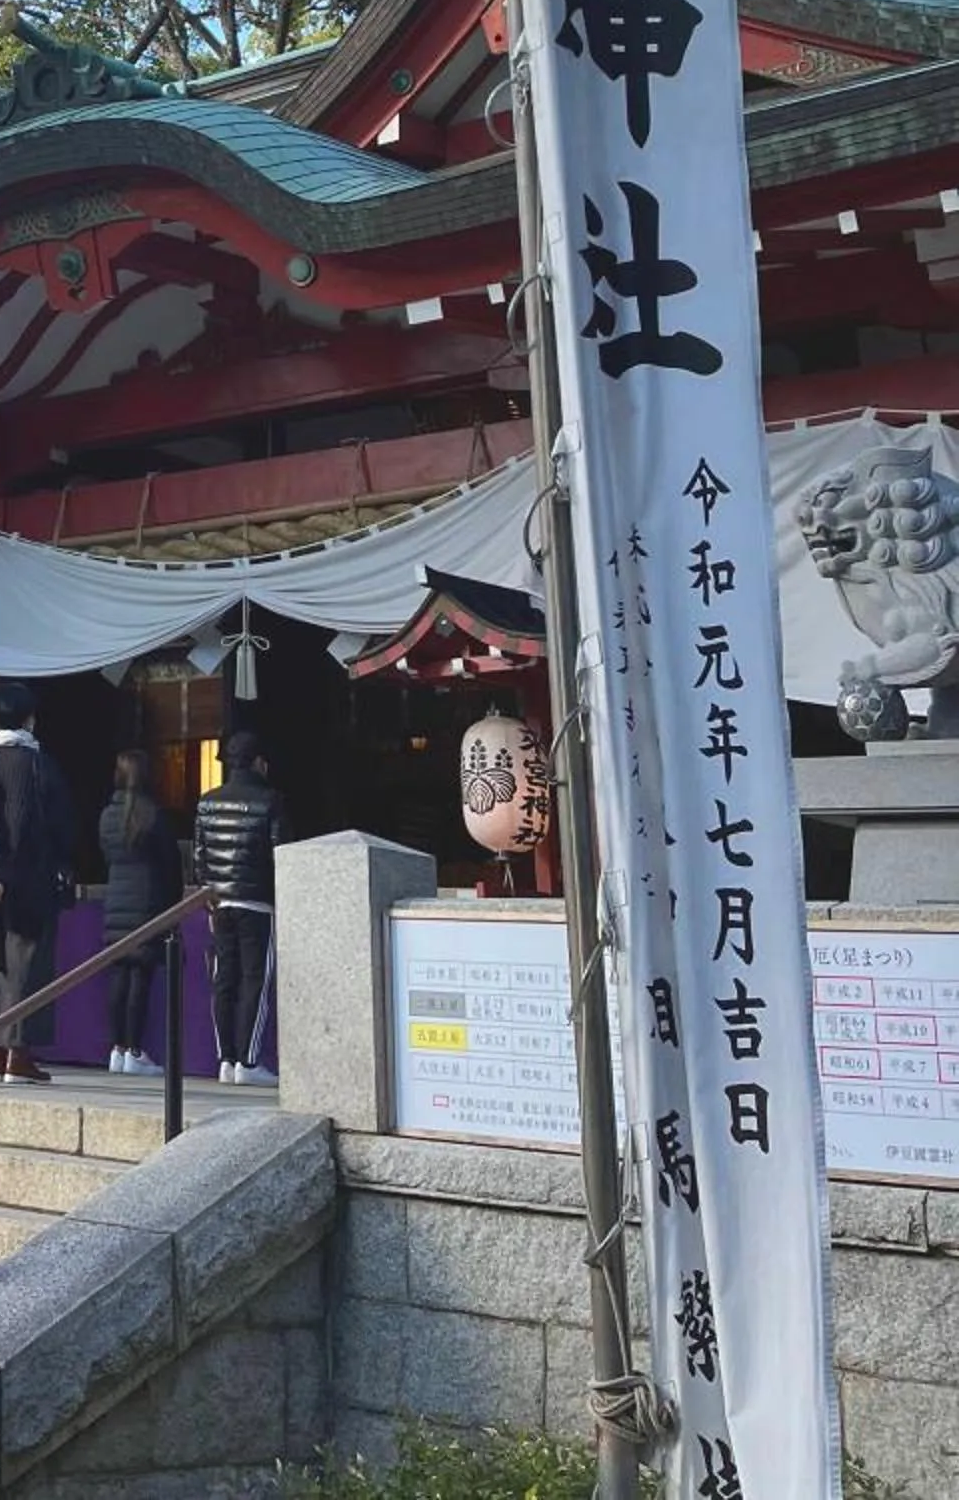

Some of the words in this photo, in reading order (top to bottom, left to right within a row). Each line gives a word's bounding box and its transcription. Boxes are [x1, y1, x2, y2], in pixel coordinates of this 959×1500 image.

[681, 456, 771, 1155] 令和元年七月吉日
